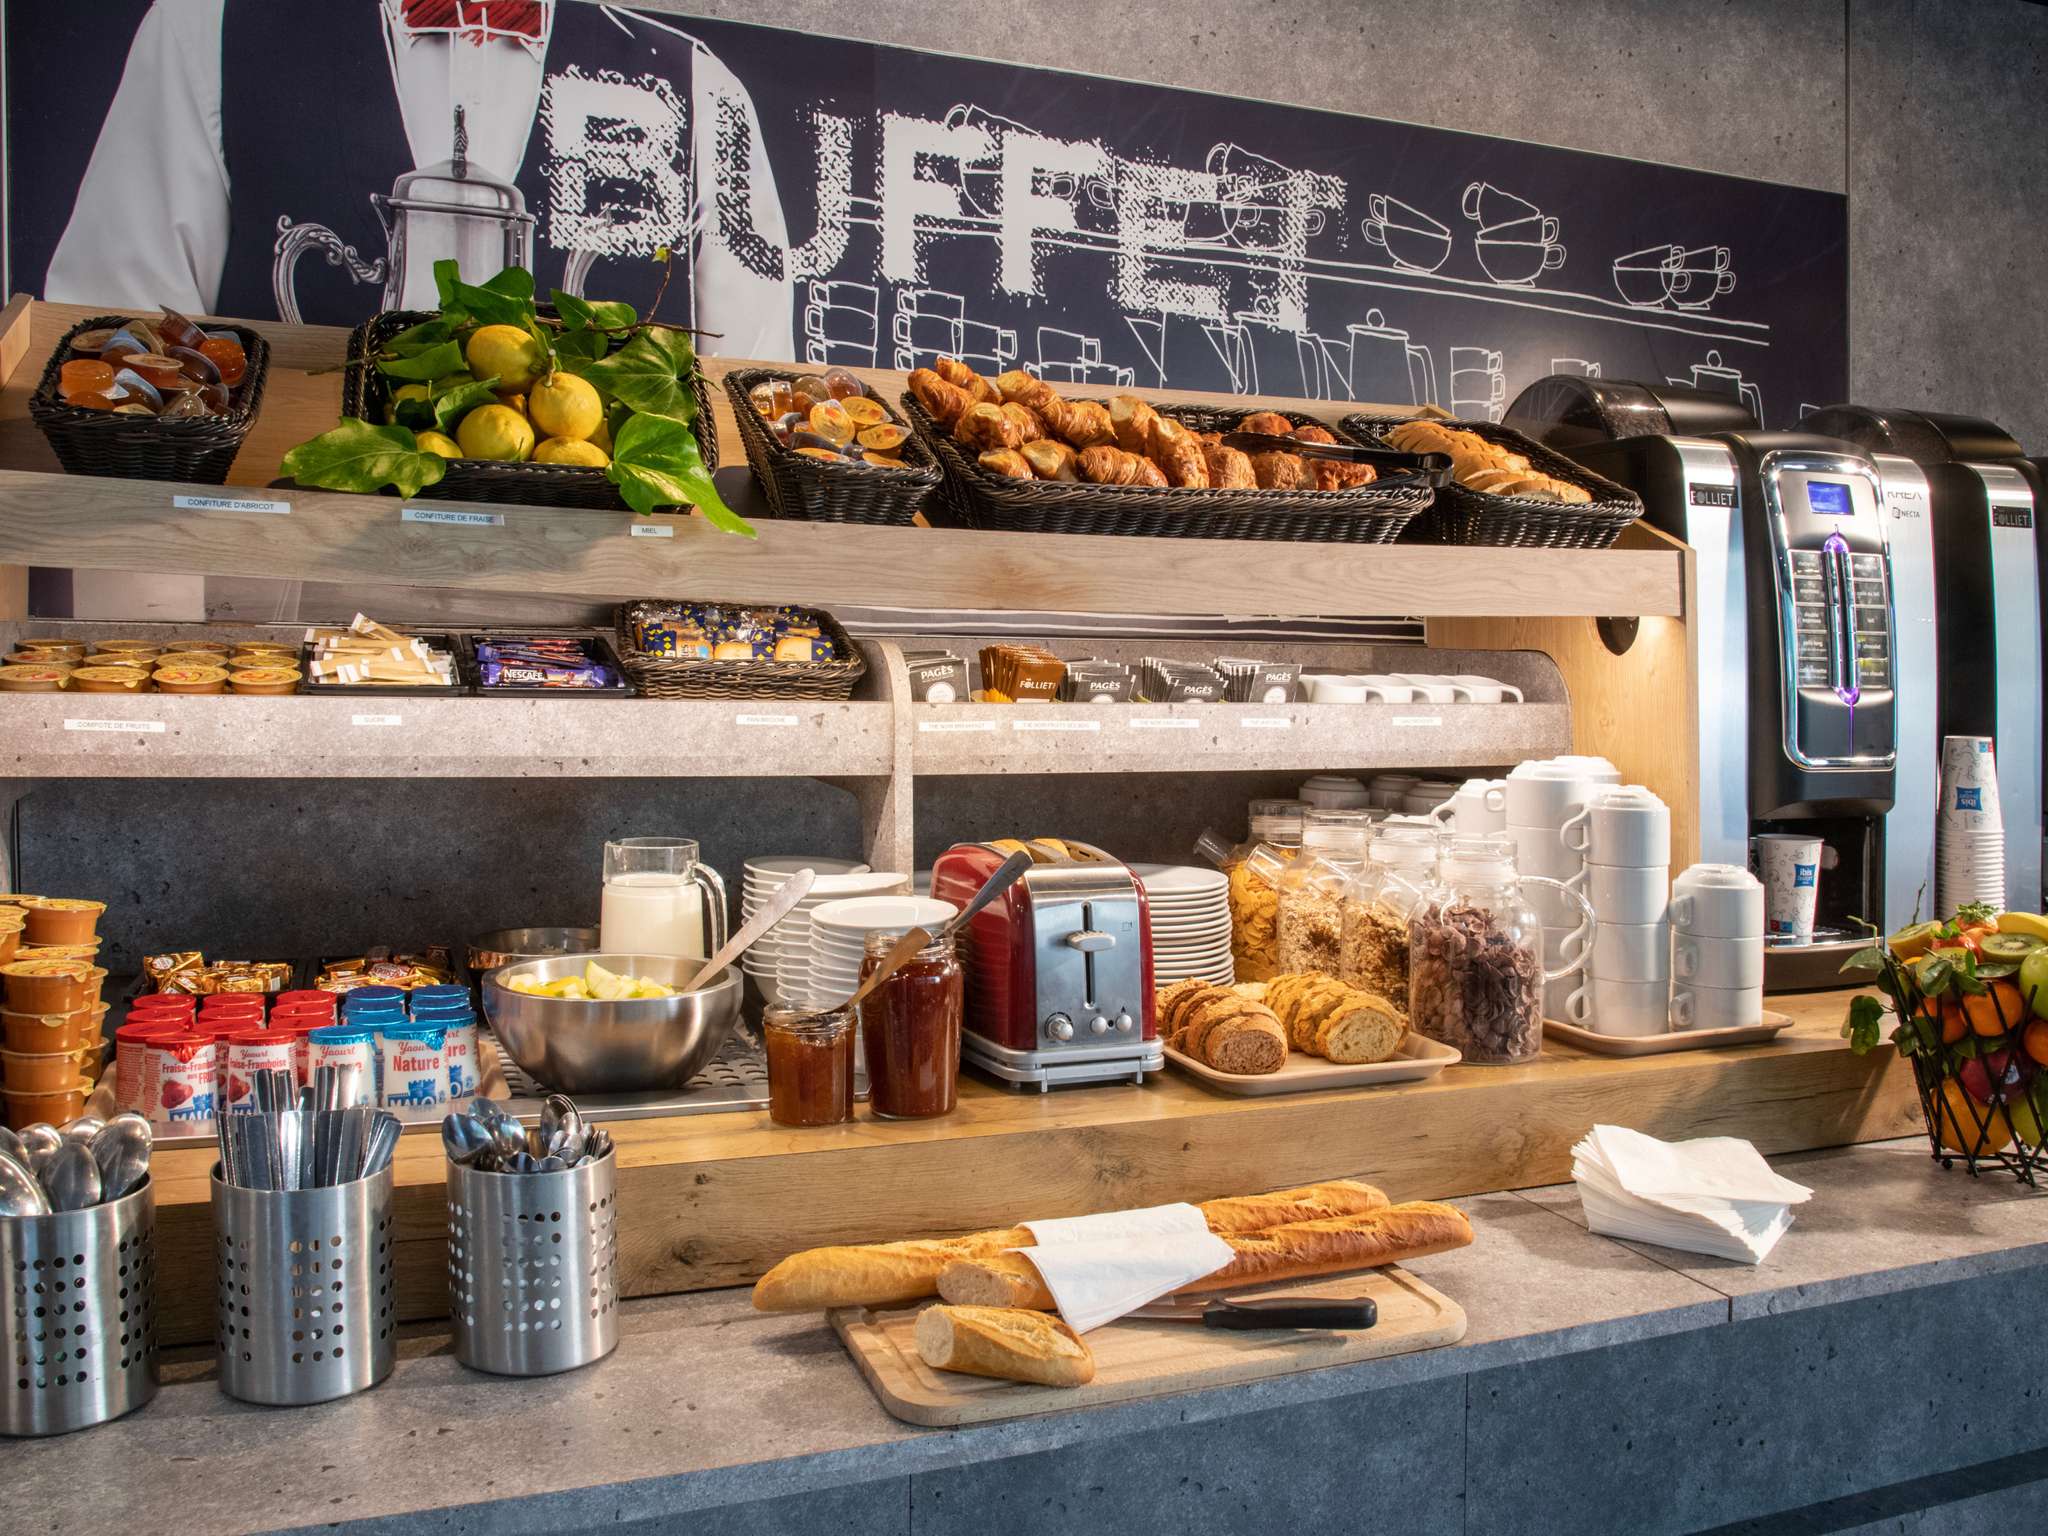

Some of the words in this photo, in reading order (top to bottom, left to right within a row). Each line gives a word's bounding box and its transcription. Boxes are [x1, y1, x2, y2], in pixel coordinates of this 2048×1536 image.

[540, 64, 1346, 332] BUFFET
[187, 498, 232, 509] CONFITURE
[234, 501, 275, 510] D'ABRICOT
[1690, 490, 1733, 506] FOLLIET
[414, 511, 456, 521] CONFITURE
[457, 514, 468, 522] DE
[920, 665, 954, 680] PAGÈS
[1266, 671, 1292, 681] PAGÈS
[1089, 680, 1121, 690] PAGÈS
[1184, 684, 1213, 694] PAGÈS
[393, 1055, 440, 1072] Nature
